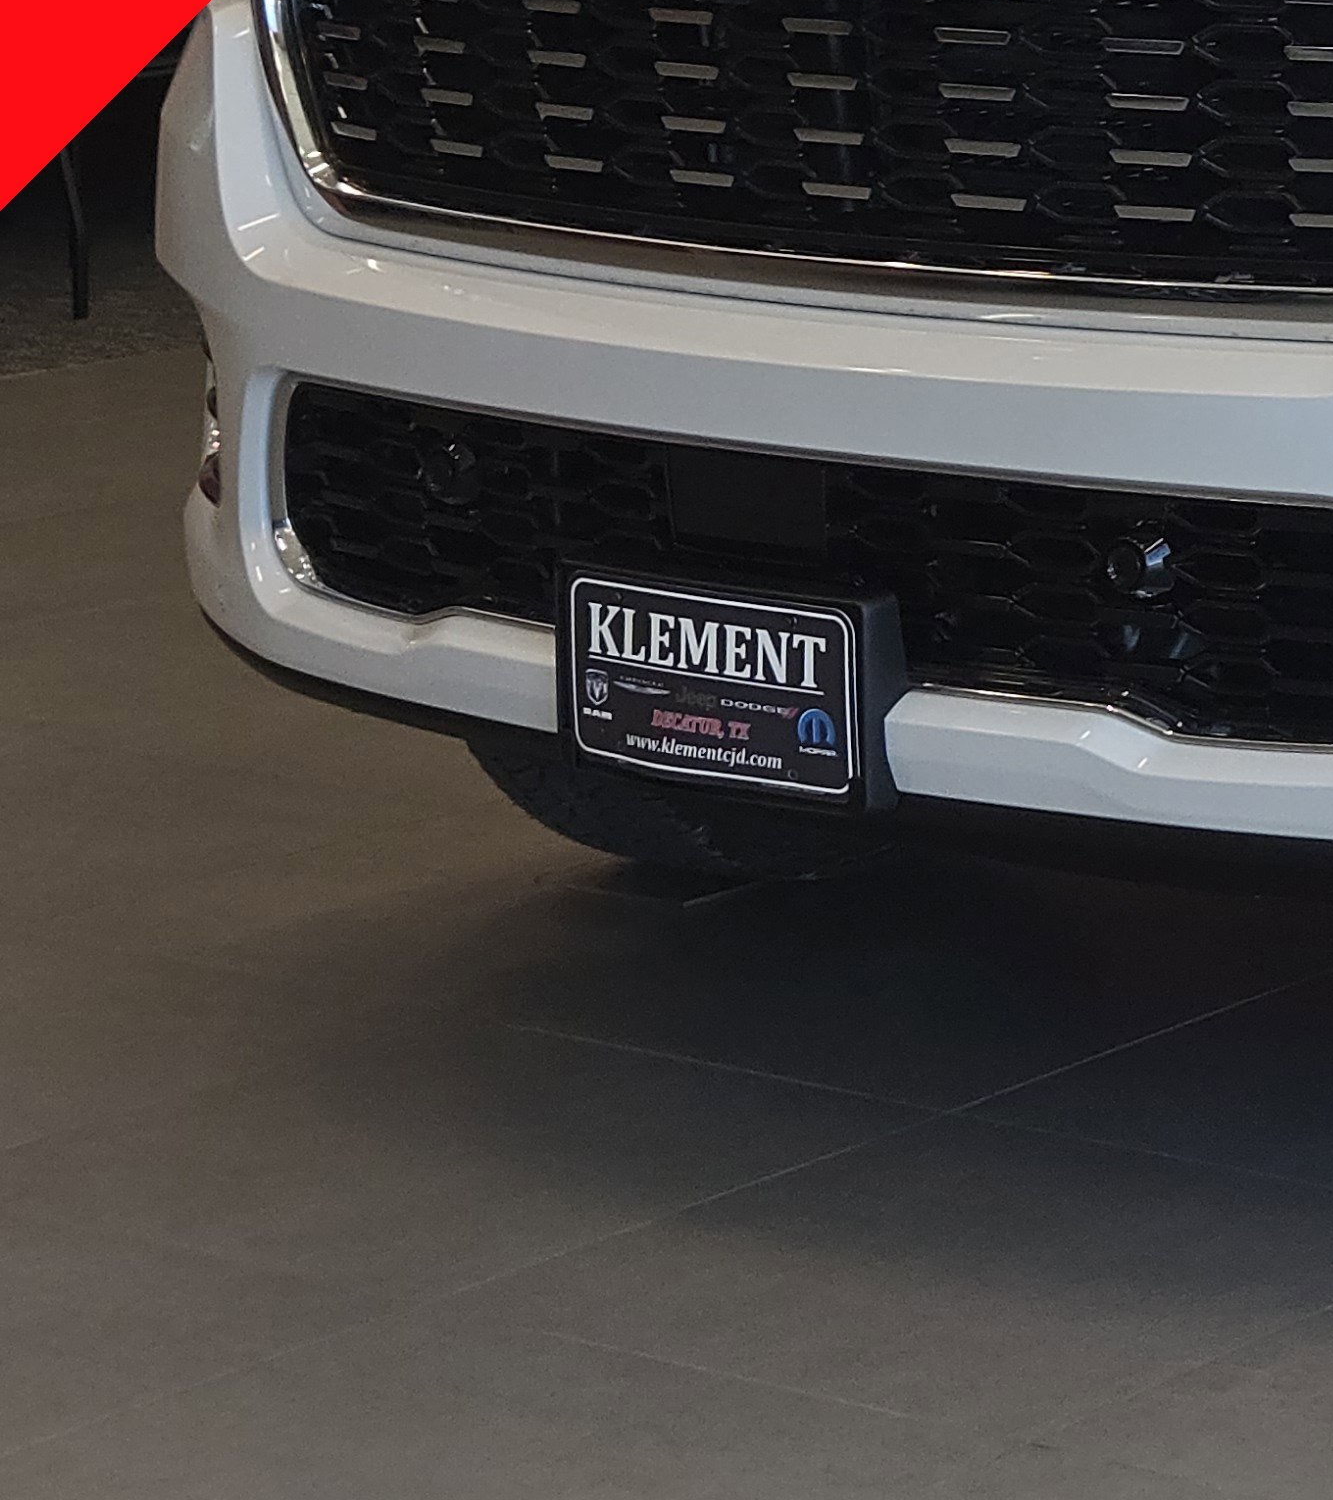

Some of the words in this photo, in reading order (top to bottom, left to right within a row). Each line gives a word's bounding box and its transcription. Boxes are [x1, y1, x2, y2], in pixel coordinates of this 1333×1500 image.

[587, 601, 828, 688] KLEMENT
[582, 706, 613, 721] RAM
[720, 698, 788, 715] DODGE
[625, 733, 783, 770] www.klementcjd.com
